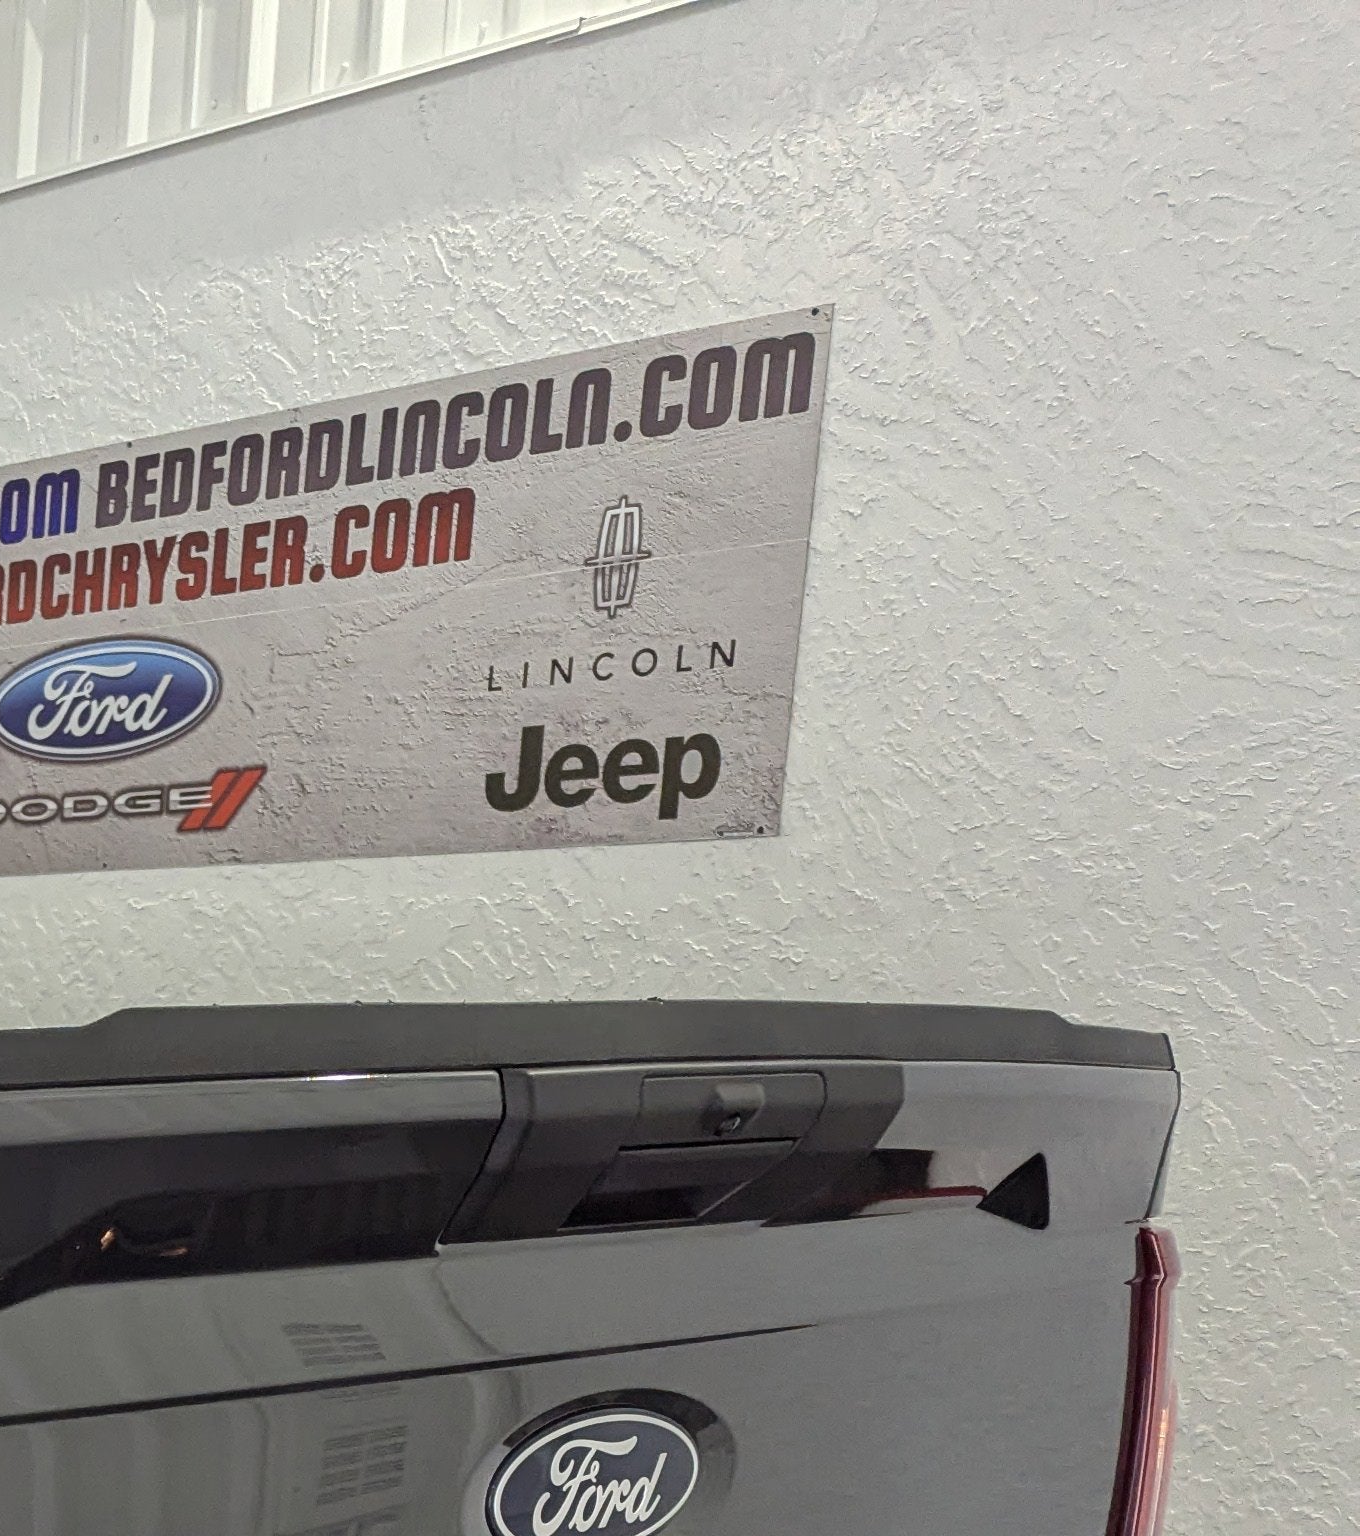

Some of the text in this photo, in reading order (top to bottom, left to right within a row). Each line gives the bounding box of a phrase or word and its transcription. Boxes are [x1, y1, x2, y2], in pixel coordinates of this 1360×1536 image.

[95, 330, 816, 529] BEDFORDLINCOLN.COM
[27, 660, 168, 740] Ford
[487, 639, 737, 692] LINCOLN
[485, 724, 721, 821] Jeep
[532, 1434, 667, 1536] Ford
